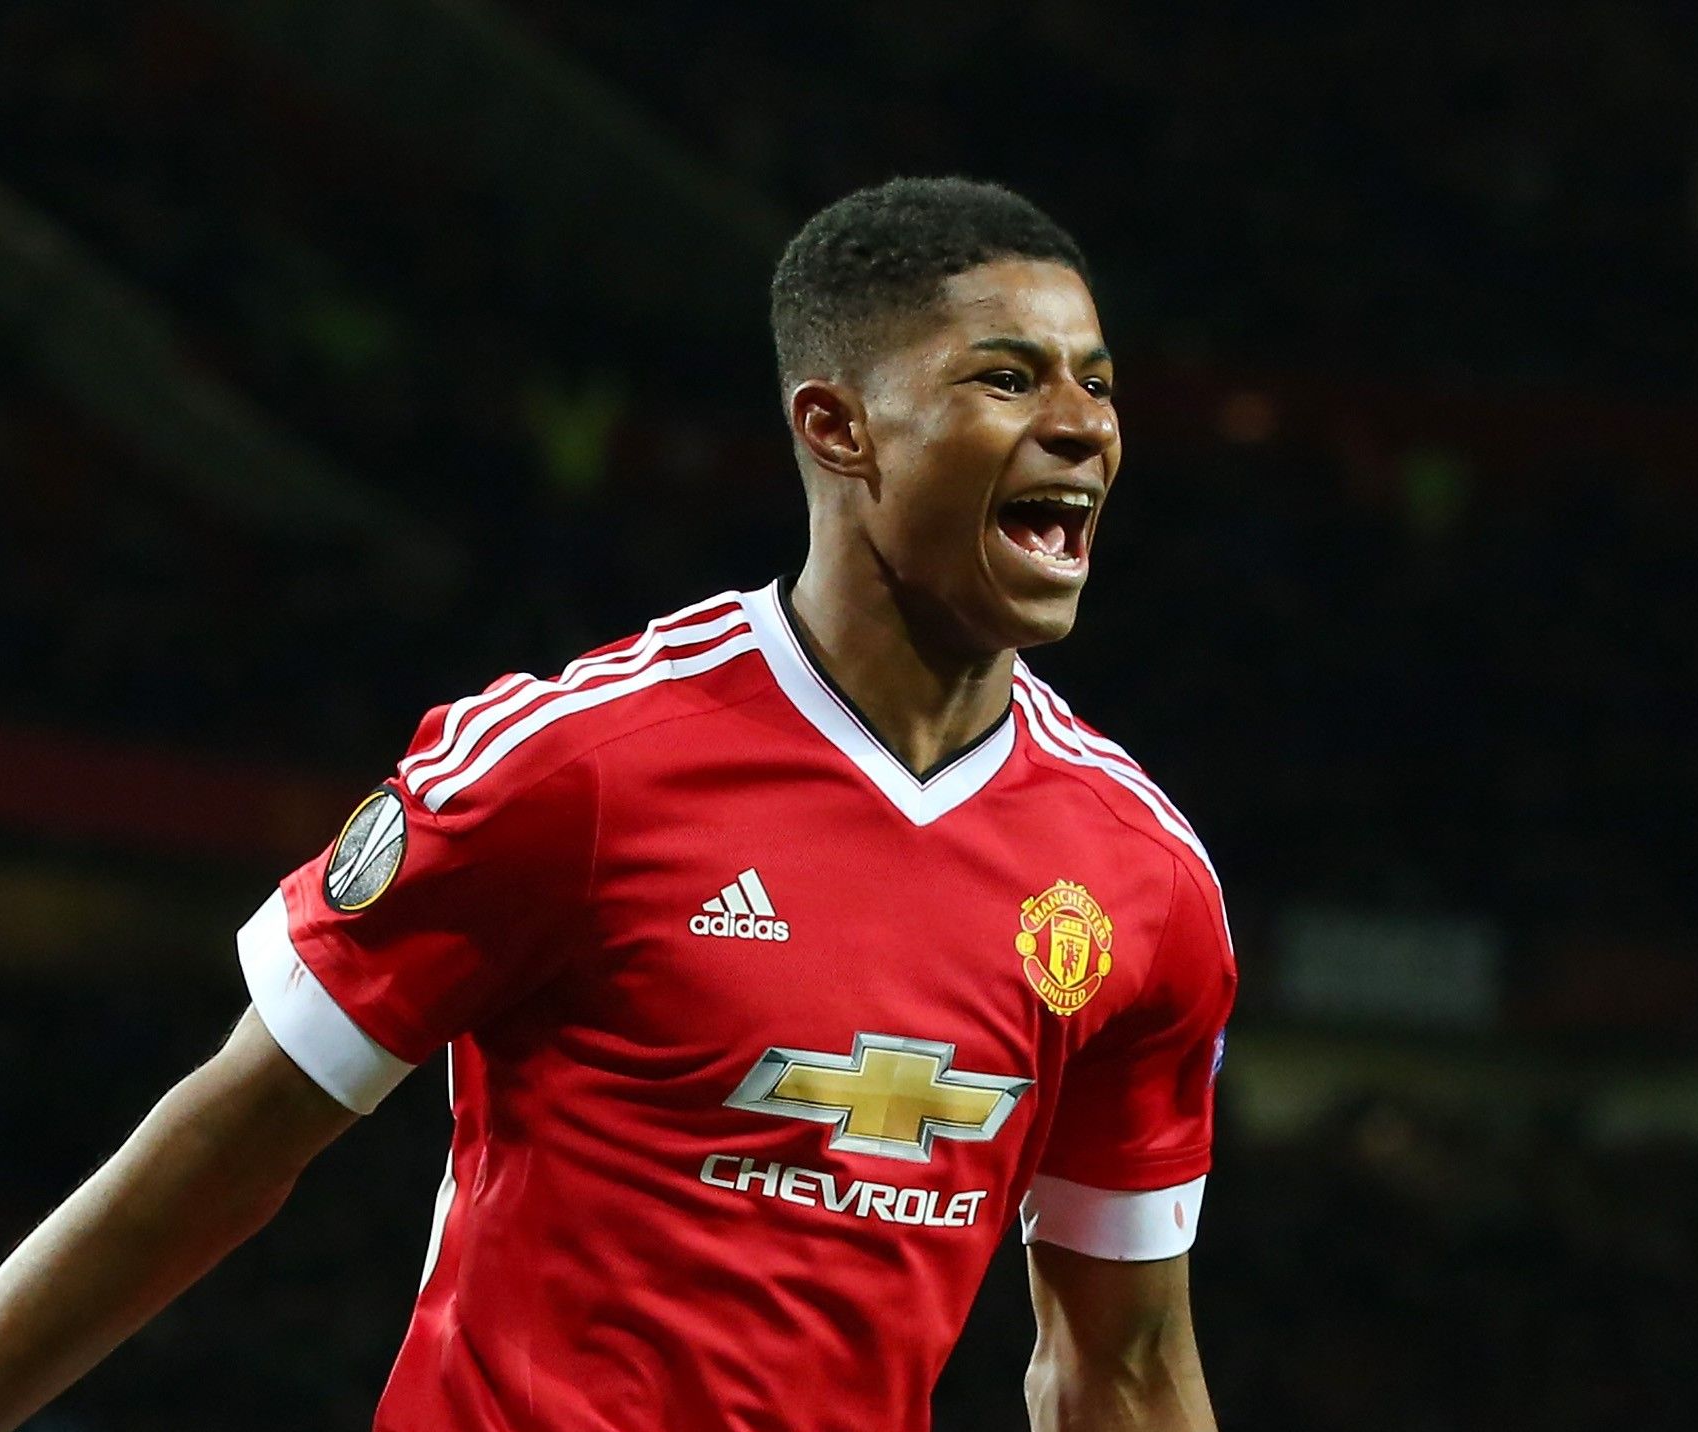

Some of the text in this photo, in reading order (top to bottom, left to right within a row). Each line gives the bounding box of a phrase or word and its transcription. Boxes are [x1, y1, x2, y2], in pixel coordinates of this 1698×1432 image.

[689, 911, 790, 942] adidas
[1028, 890, 1107, 942] MANCHESTER
[1039, 977, 1087, 1007] UNITED
[699, 1154, 988, 1227] CHEVROLET
